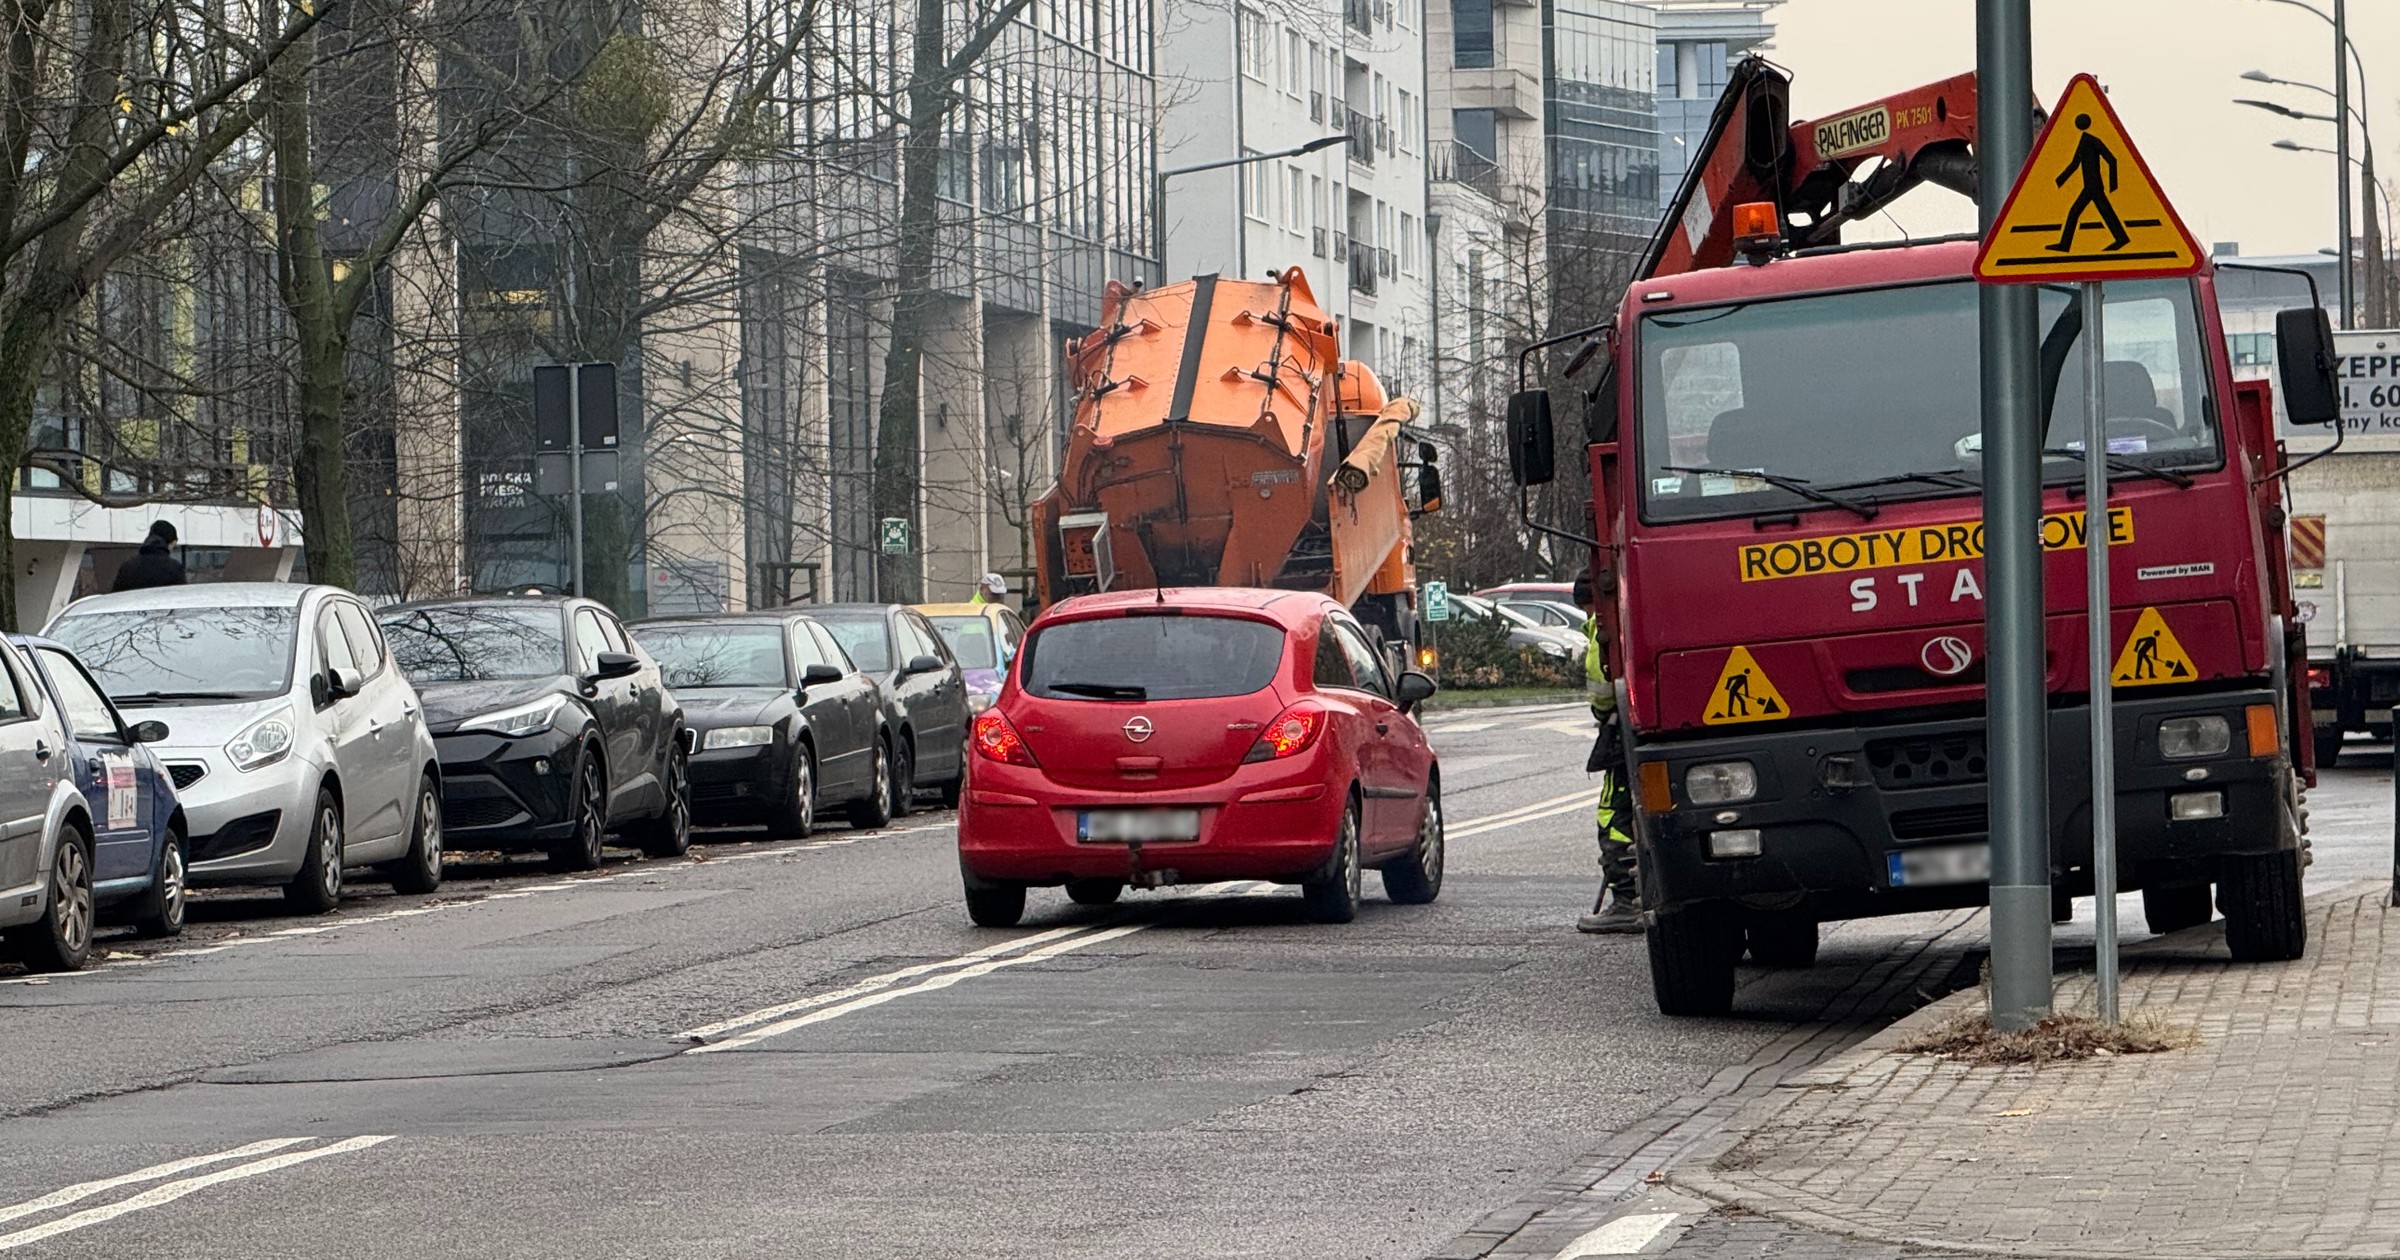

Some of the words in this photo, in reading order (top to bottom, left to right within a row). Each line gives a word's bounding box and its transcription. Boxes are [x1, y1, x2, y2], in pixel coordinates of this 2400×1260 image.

[1817, 110, 1886, 154] PALFINGER
[1895, 109, 1910, 130] PK
[1911, 106, 1933, 127] 7501
[1745, 531, 1906, 579] ROBOTY
[1920, 510, 2127, 560] DROWE
[1849, 568, 1985, 612] STA
[2140, 567, 2177, 578] Powered
[2178, 566, 2189, 576] by
[2190, 563, 2211, 573] MAN
